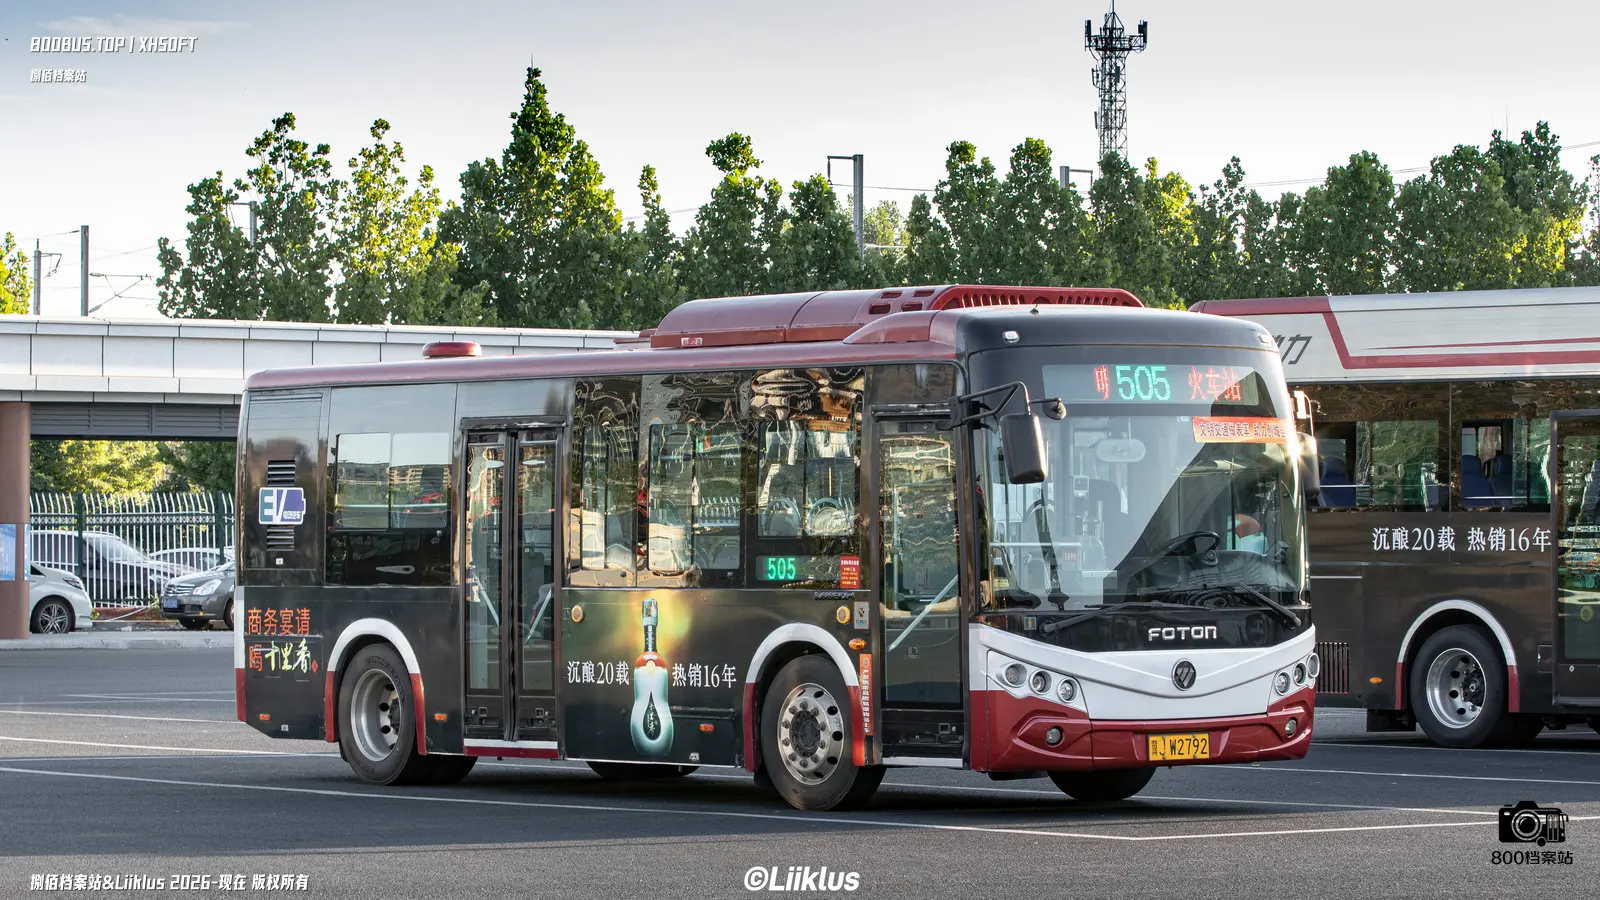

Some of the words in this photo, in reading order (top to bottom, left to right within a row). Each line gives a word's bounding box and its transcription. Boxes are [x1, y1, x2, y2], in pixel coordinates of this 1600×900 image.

[1115, 365, 1171, 401] 505
[1187, 366, 1242, 402] 火车站
[260, 488, 288, 523] EV
[1372, 526, 1456, 551] 沉酿20载
[1467, 526, 1552, 552] 热销16年
[767, 557, 796, 580] 505
[247, 607, 311, 636] 商务宴请
[1148, 626, 1218, 641] FOTON
[567, 660, 630, 686] 沉酿20载
[671, 663, 737, 689] 热销16年
